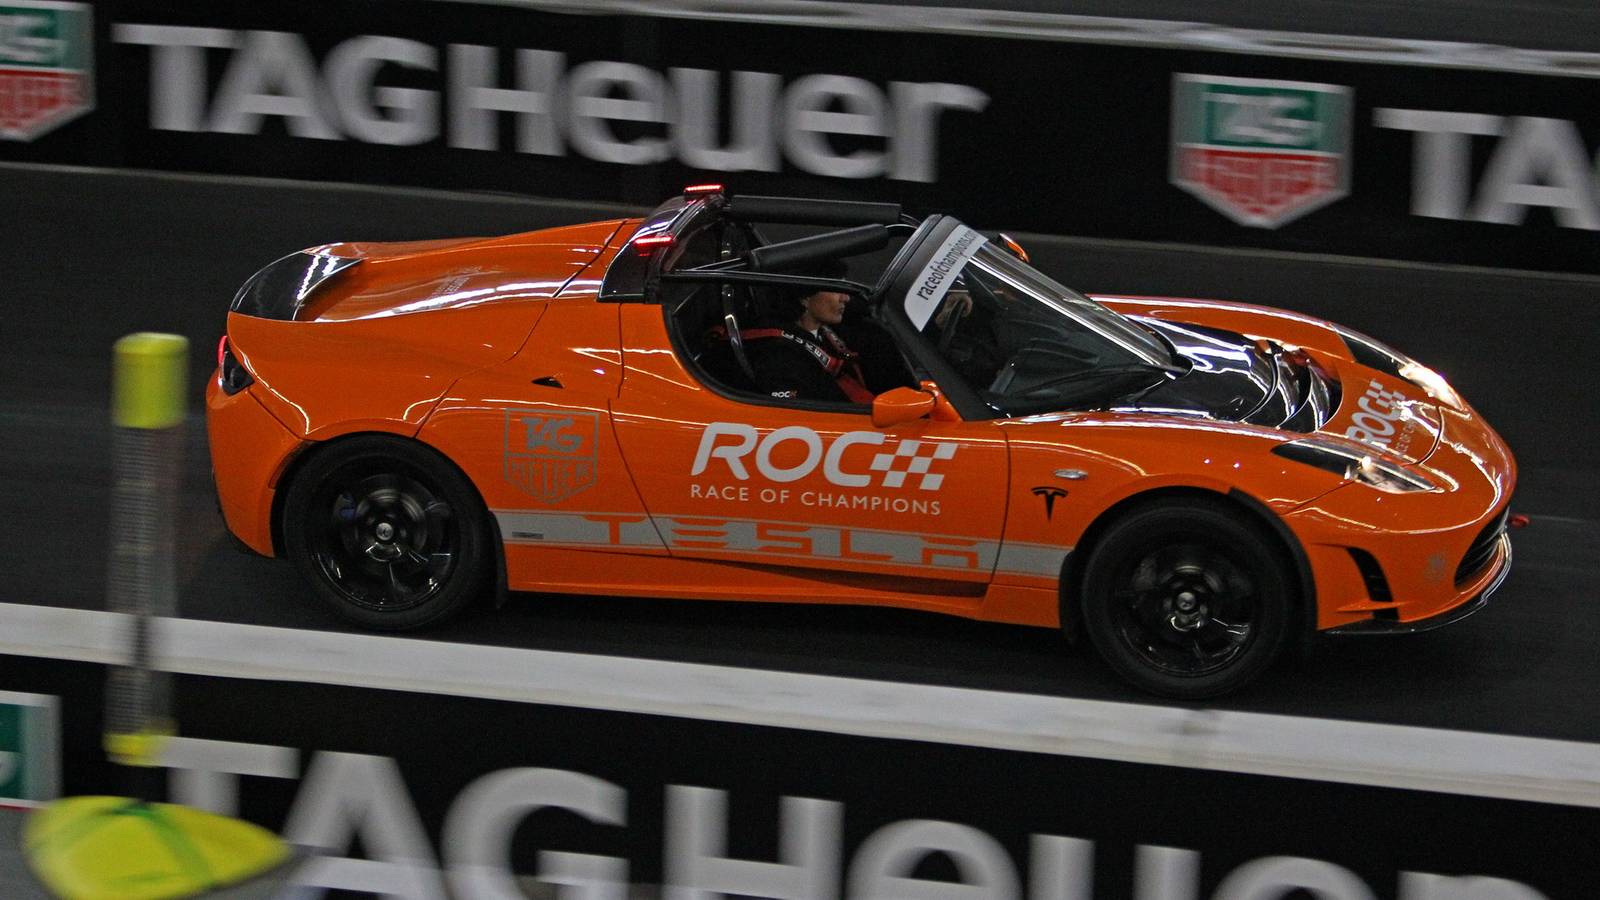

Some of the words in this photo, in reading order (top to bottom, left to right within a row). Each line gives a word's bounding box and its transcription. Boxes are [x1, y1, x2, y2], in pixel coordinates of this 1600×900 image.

[690, 484, 749, 502] RACE
[760, 488, 791, 504] OF
[801, 491, 942, 516] CHAMPIONS
